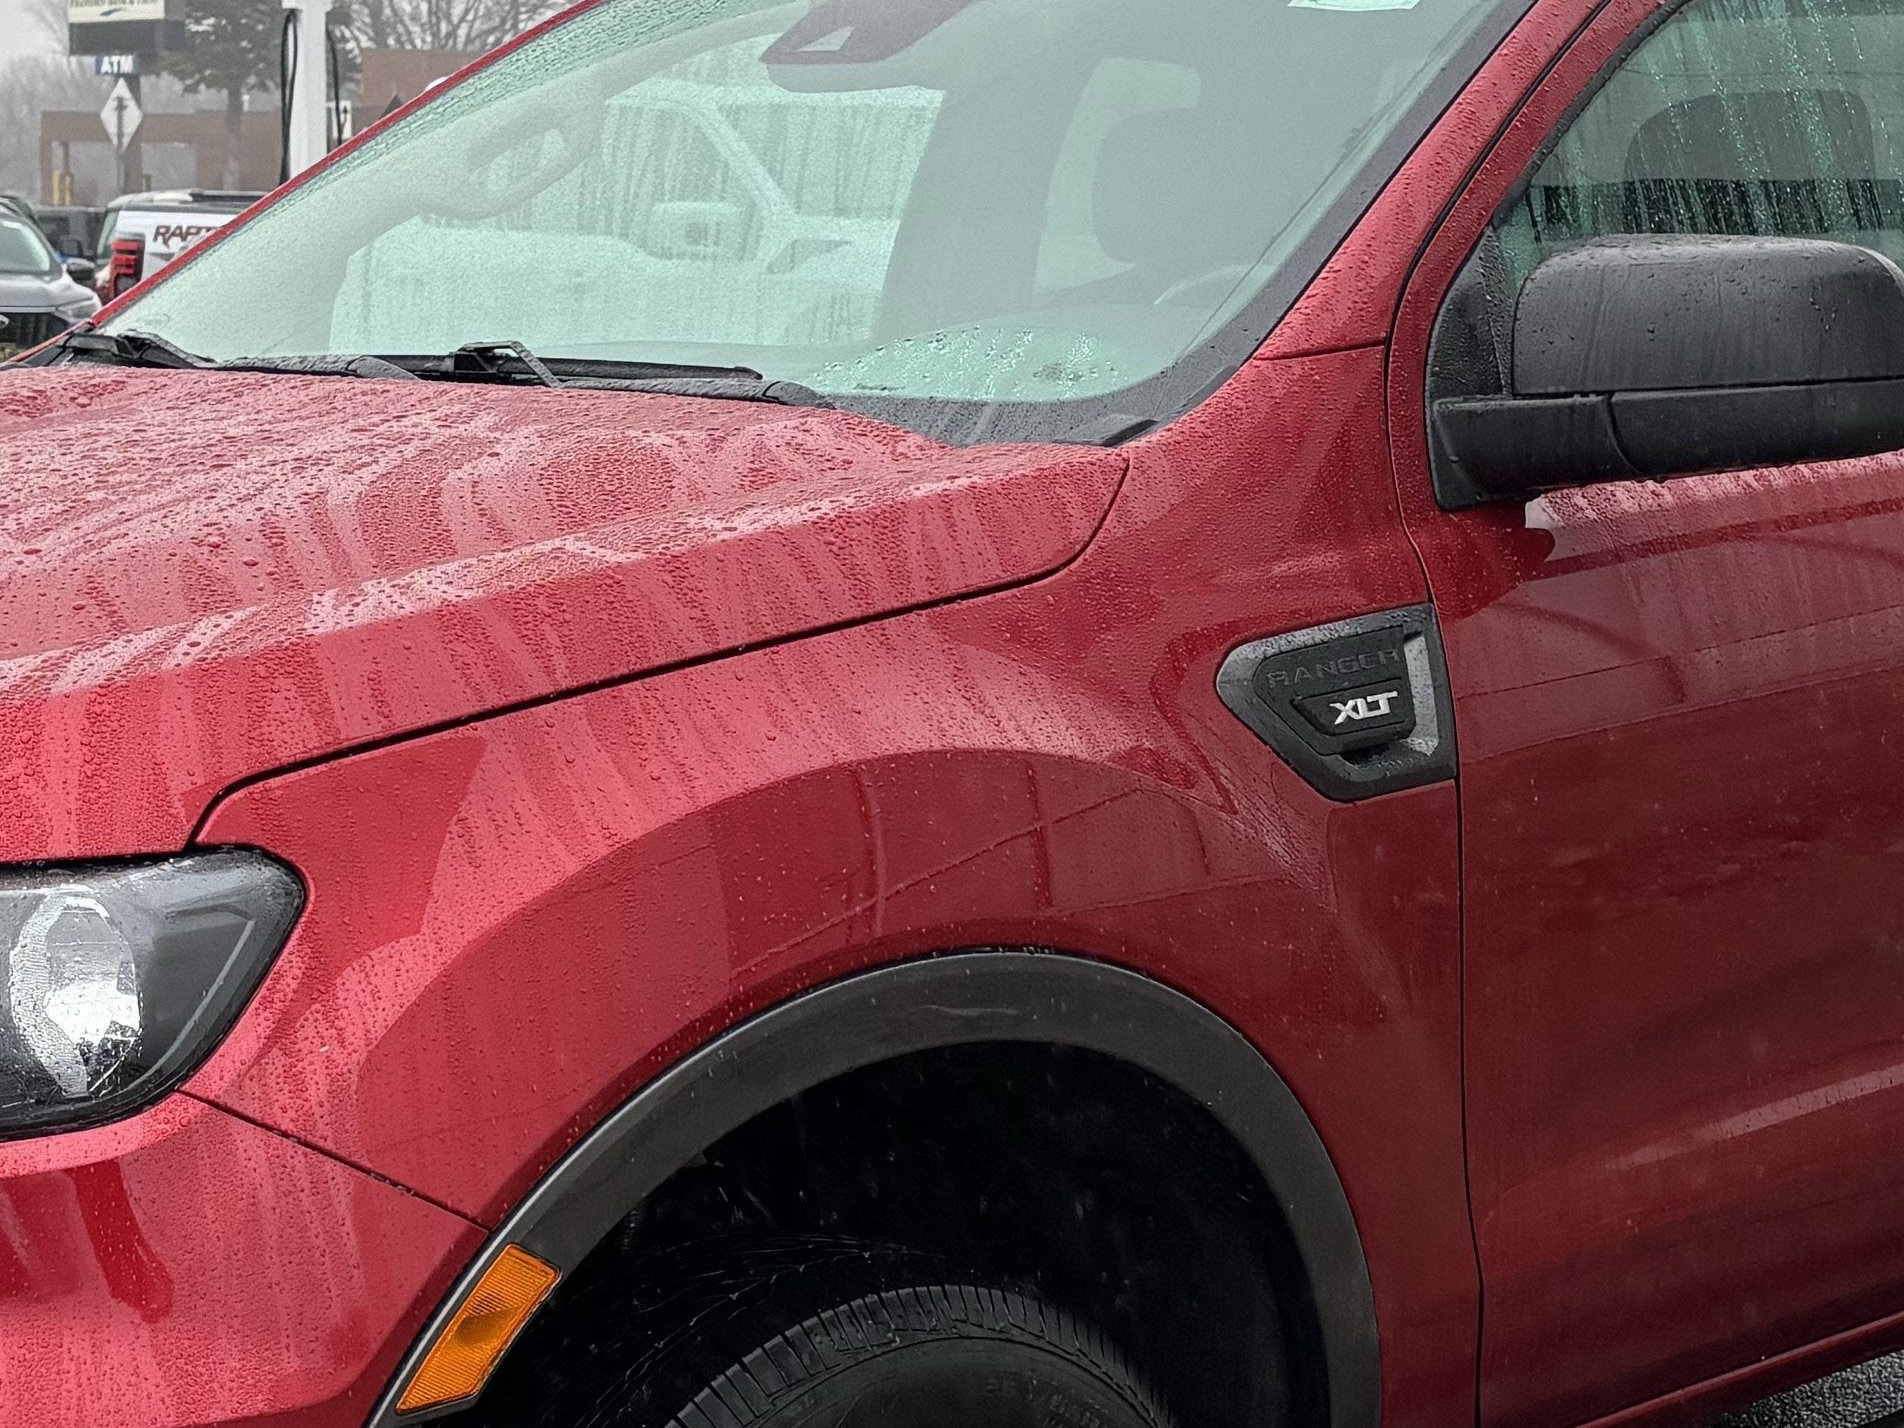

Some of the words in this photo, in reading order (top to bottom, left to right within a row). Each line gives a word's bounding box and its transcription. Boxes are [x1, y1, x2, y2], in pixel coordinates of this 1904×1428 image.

[100, 55, 133, 74] ATM
[1266, 649, 1397, 689] RANGER
[1329, 690, 1398, 725] XLT
